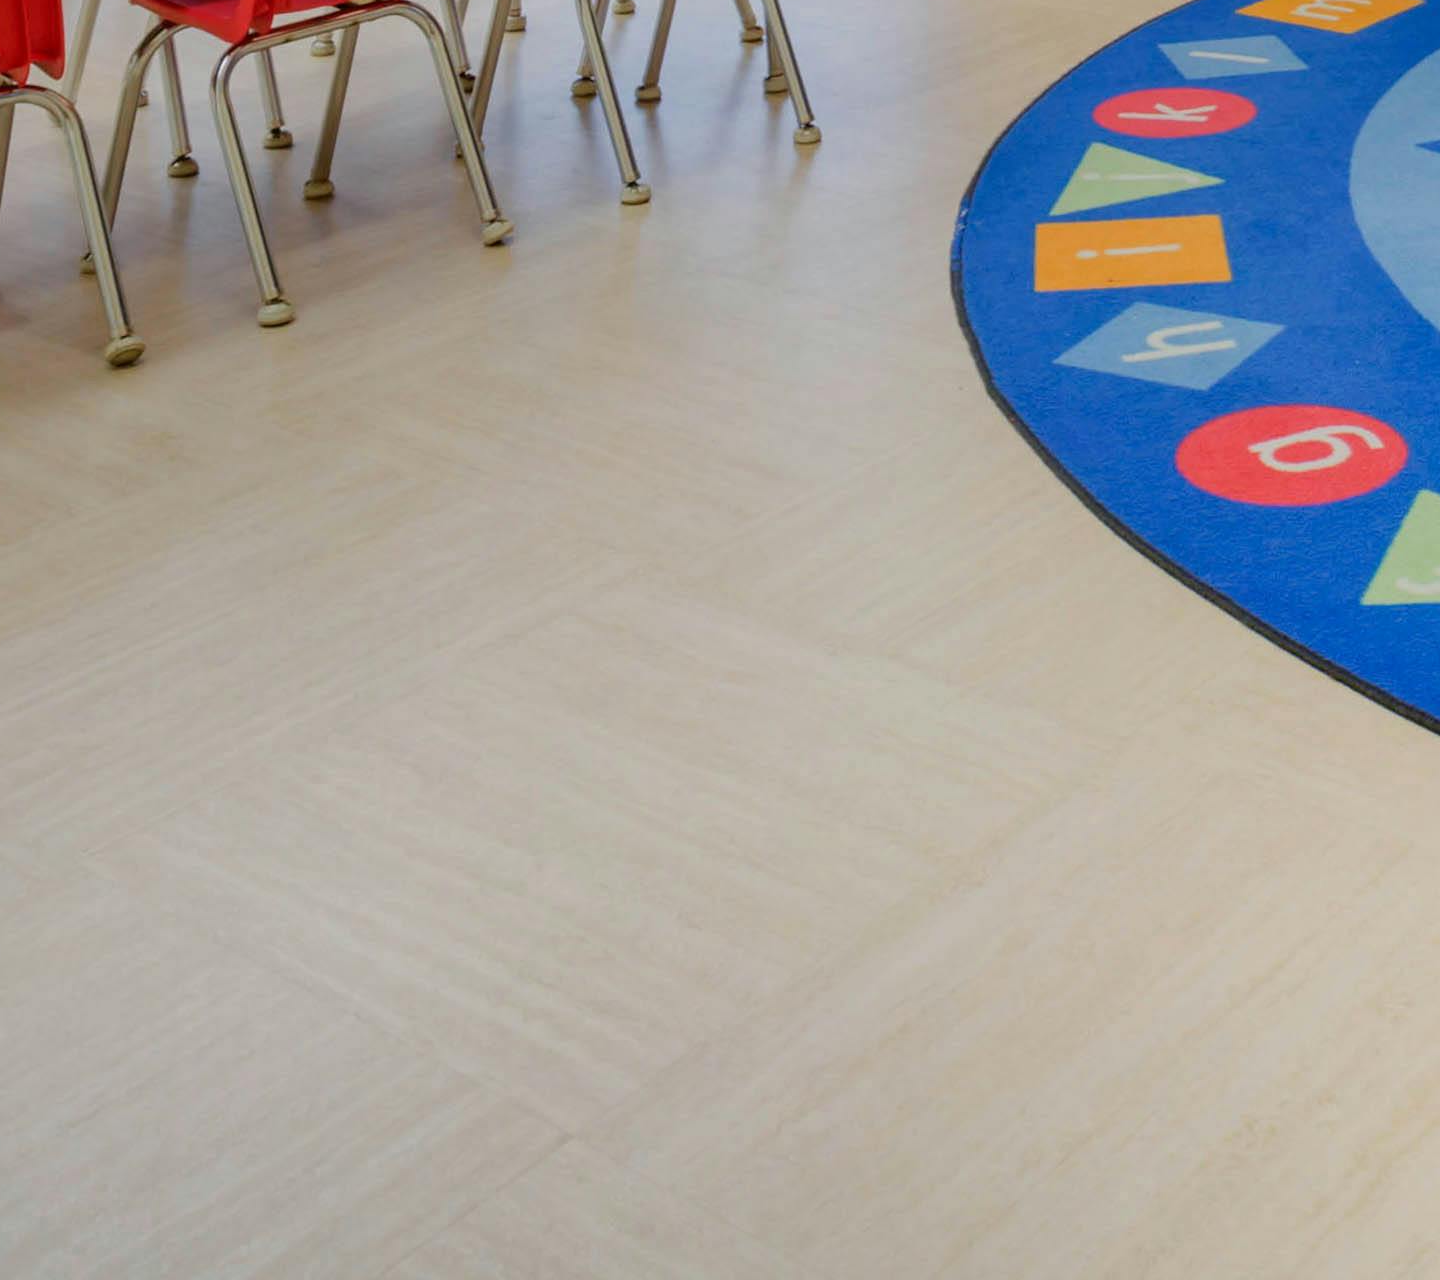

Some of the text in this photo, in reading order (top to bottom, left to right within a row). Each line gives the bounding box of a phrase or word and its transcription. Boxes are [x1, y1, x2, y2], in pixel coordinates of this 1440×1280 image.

[1118, 103, 1218, 123] k
[1076, 243, 1181, 259] i
[1120, 319, 1237, 363] h
[1248, 425, 1384, 472] g
